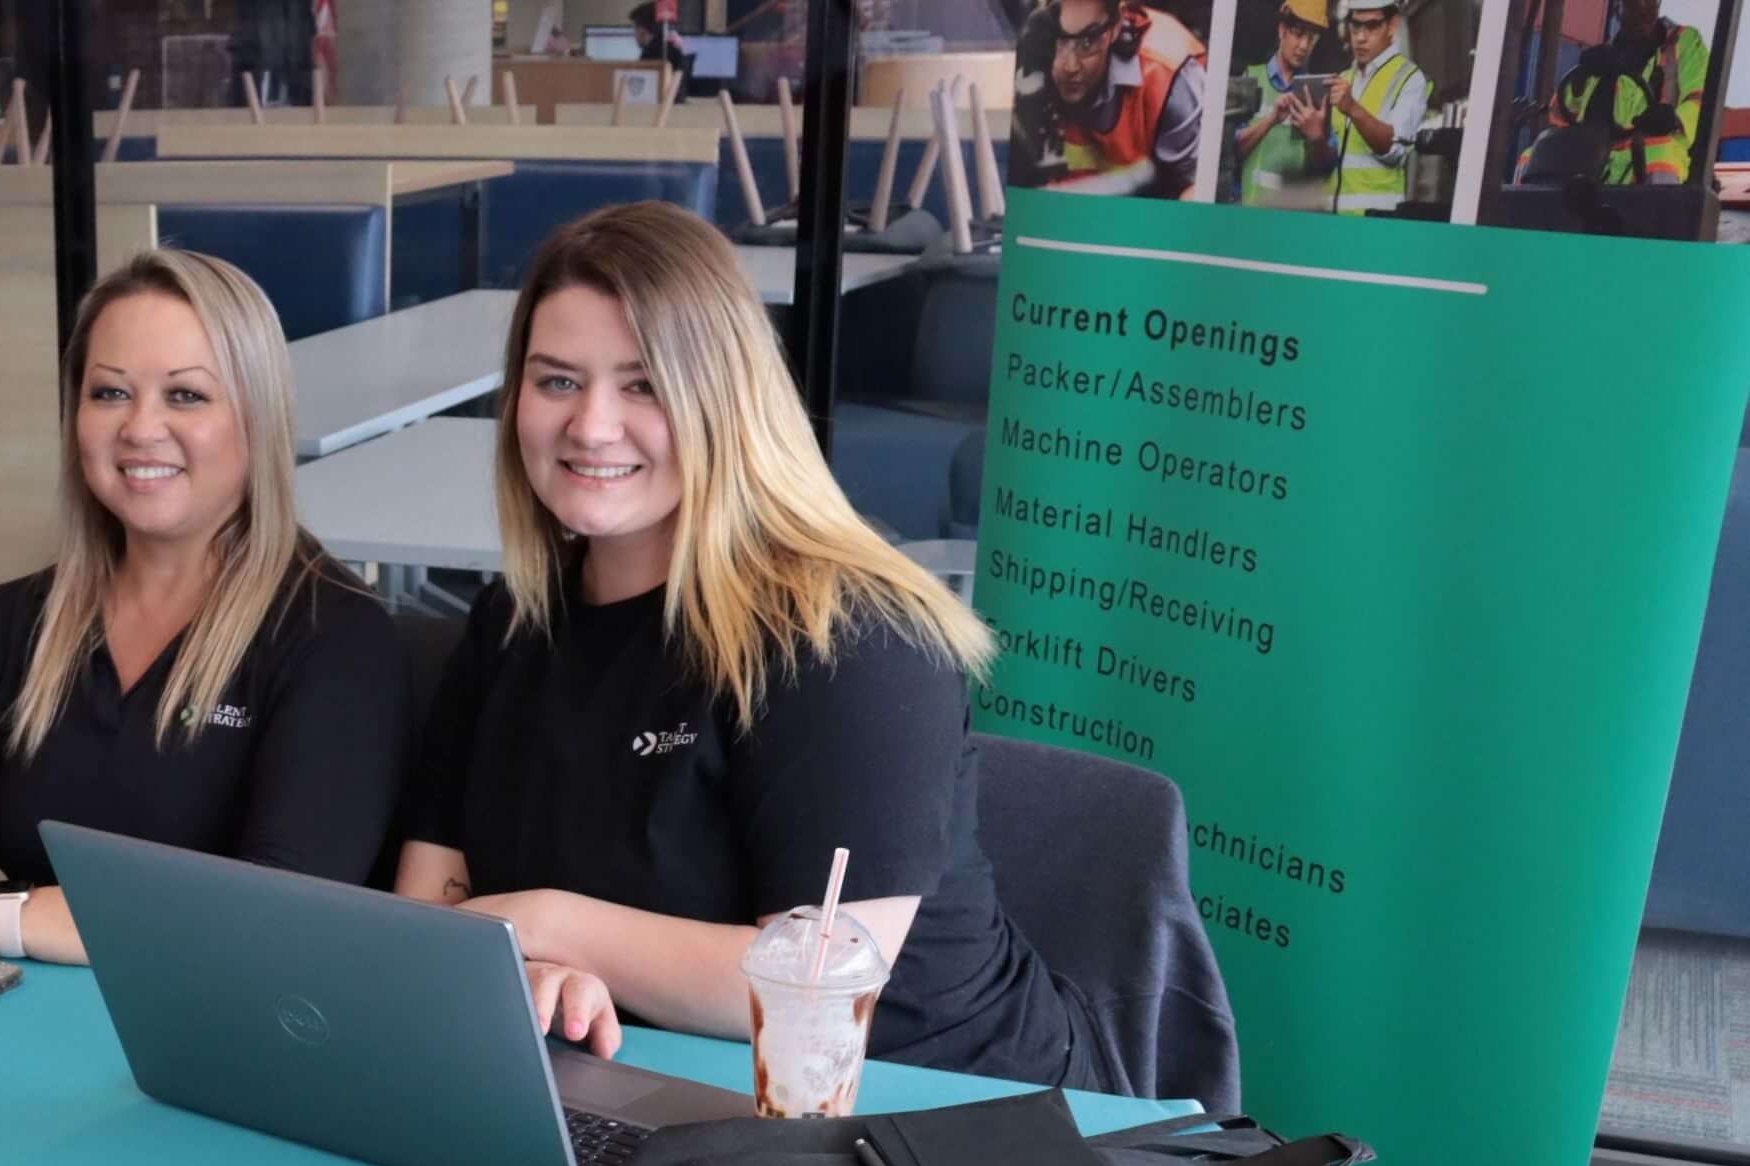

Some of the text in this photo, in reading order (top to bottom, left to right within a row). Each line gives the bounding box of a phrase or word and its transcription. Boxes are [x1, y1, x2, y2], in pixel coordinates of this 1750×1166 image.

[1012, 293, 1299, 367] Current Openings
[1007, 353, 1306, 431] Packer/Assemblers
[1001, 416, 1288, 500] Machine Operators
[995, 487, 1258, 573] Material Handlers
[989, 549, 1275, 655] Shipping/Receiving
[1097, 645, 1196, 703] Drivers
[978, 684, 1155, 761] Construction
[1187, 823, 1346, 894] chnicians
[1192, 893, 1291, 948] ciates
